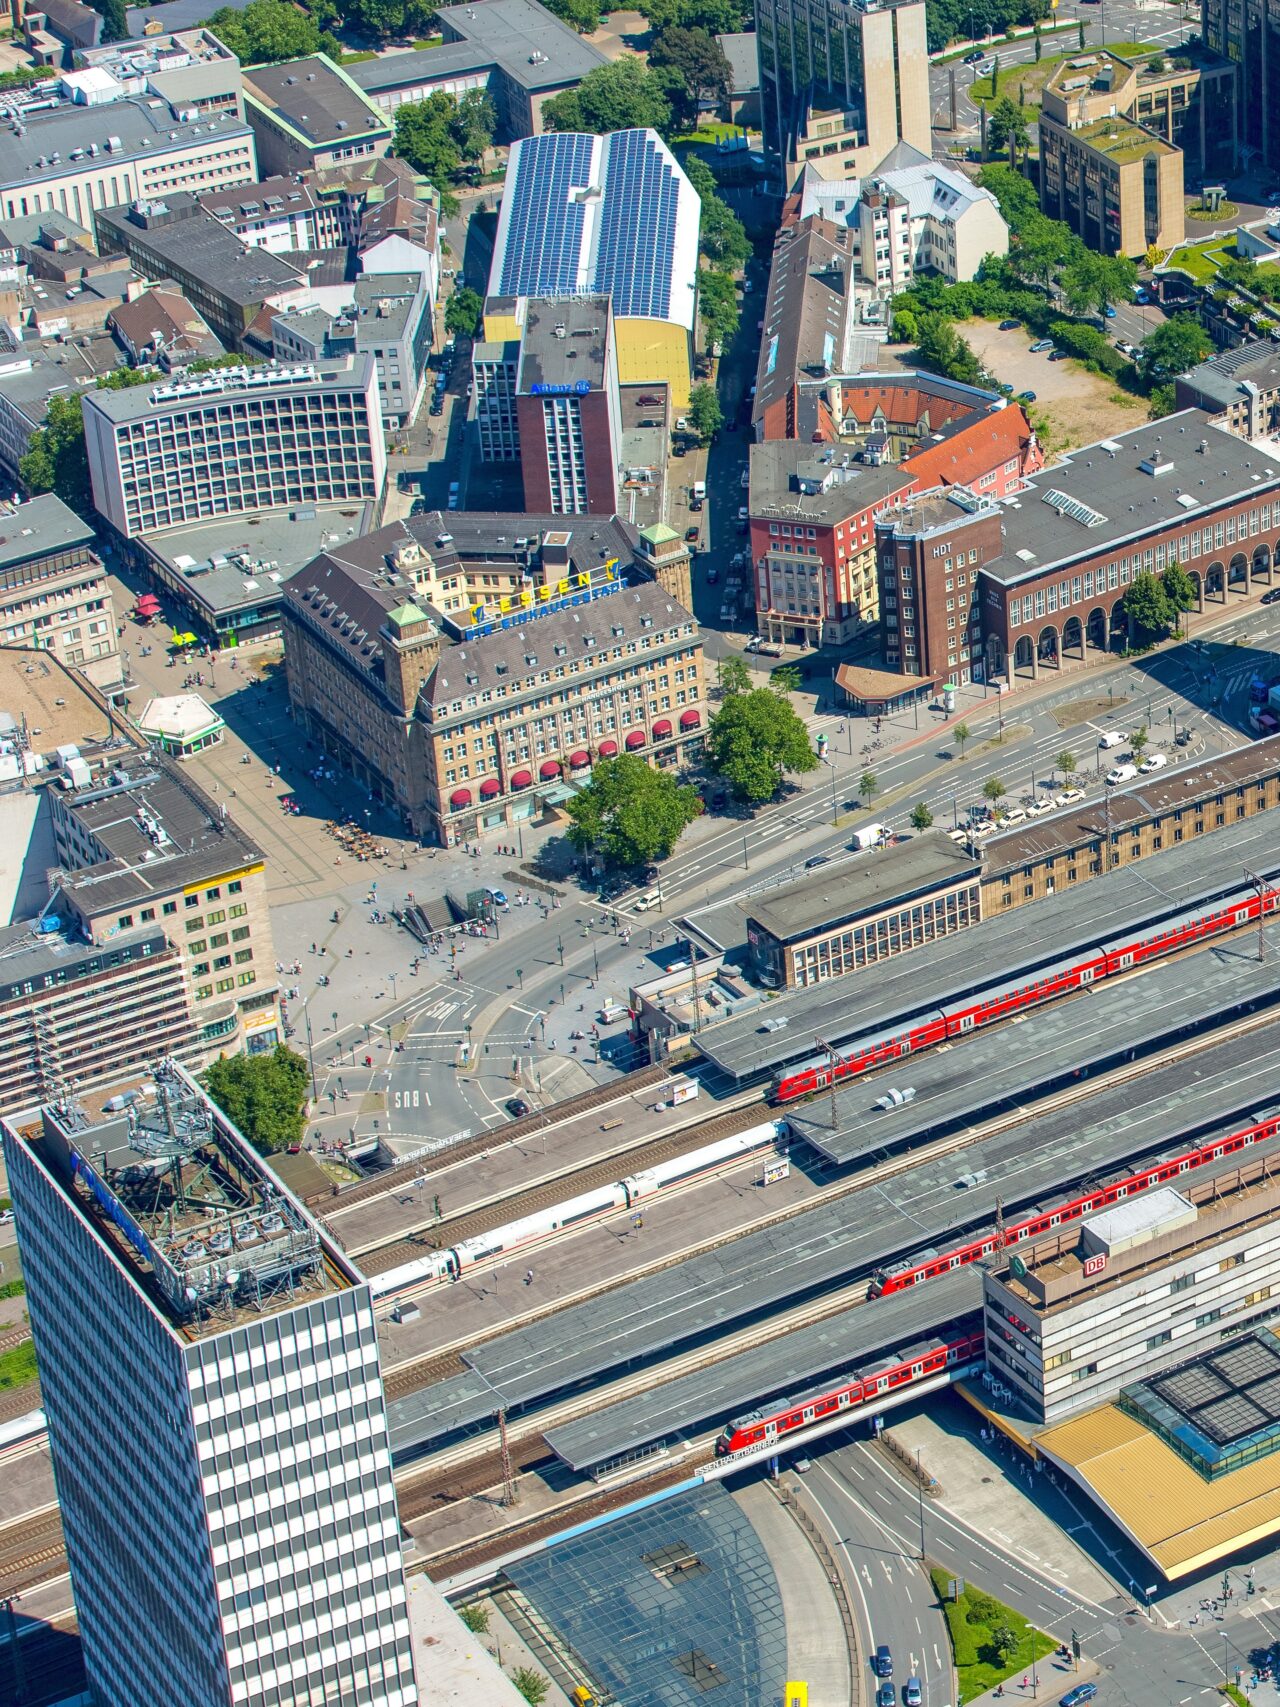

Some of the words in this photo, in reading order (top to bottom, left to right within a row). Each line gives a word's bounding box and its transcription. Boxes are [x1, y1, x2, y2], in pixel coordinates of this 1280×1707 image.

[531, 384, 572, 393] Allianz
[933, 542, 952, 558] HDT
[500, 571, 590, 613] ESSEN
[502, 579, 628, 630] EINKAUFSSTADT
[581, 684, 625, 702] HANDELSHOF
[426, 1001, 457, 1020] BUS
[395, 1090, 420, 1108] BUS
[1088, 1257, 1105, 1273] DB
[695, 1459, 721, 1477] ESSEN
[721, 1436, 779, 1466] HAUPTBAHNHOF
